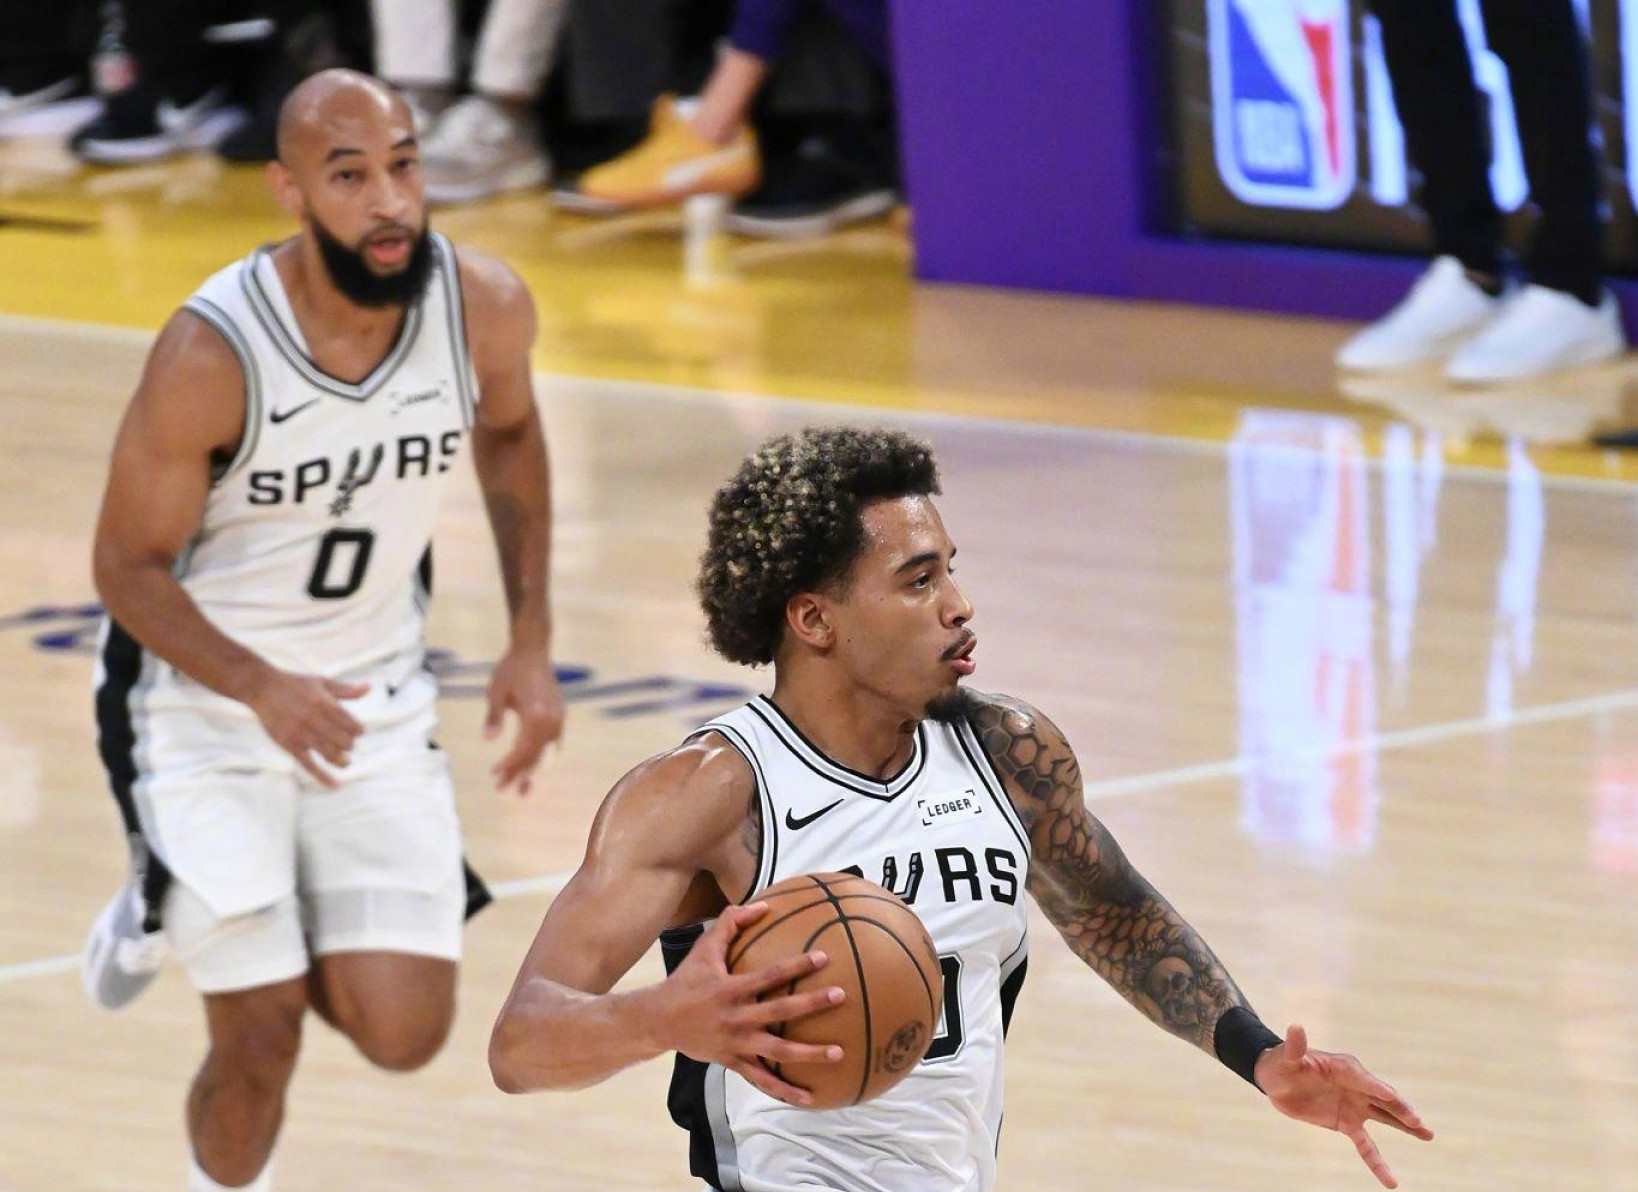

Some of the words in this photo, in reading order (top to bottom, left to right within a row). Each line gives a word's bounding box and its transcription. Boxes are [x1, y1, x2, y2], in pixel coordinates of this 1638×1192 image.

[306, 526, 376, 600] 0
[927, 798, 972, 818] LEDGER
[838, 847, 1019, 906] URS
